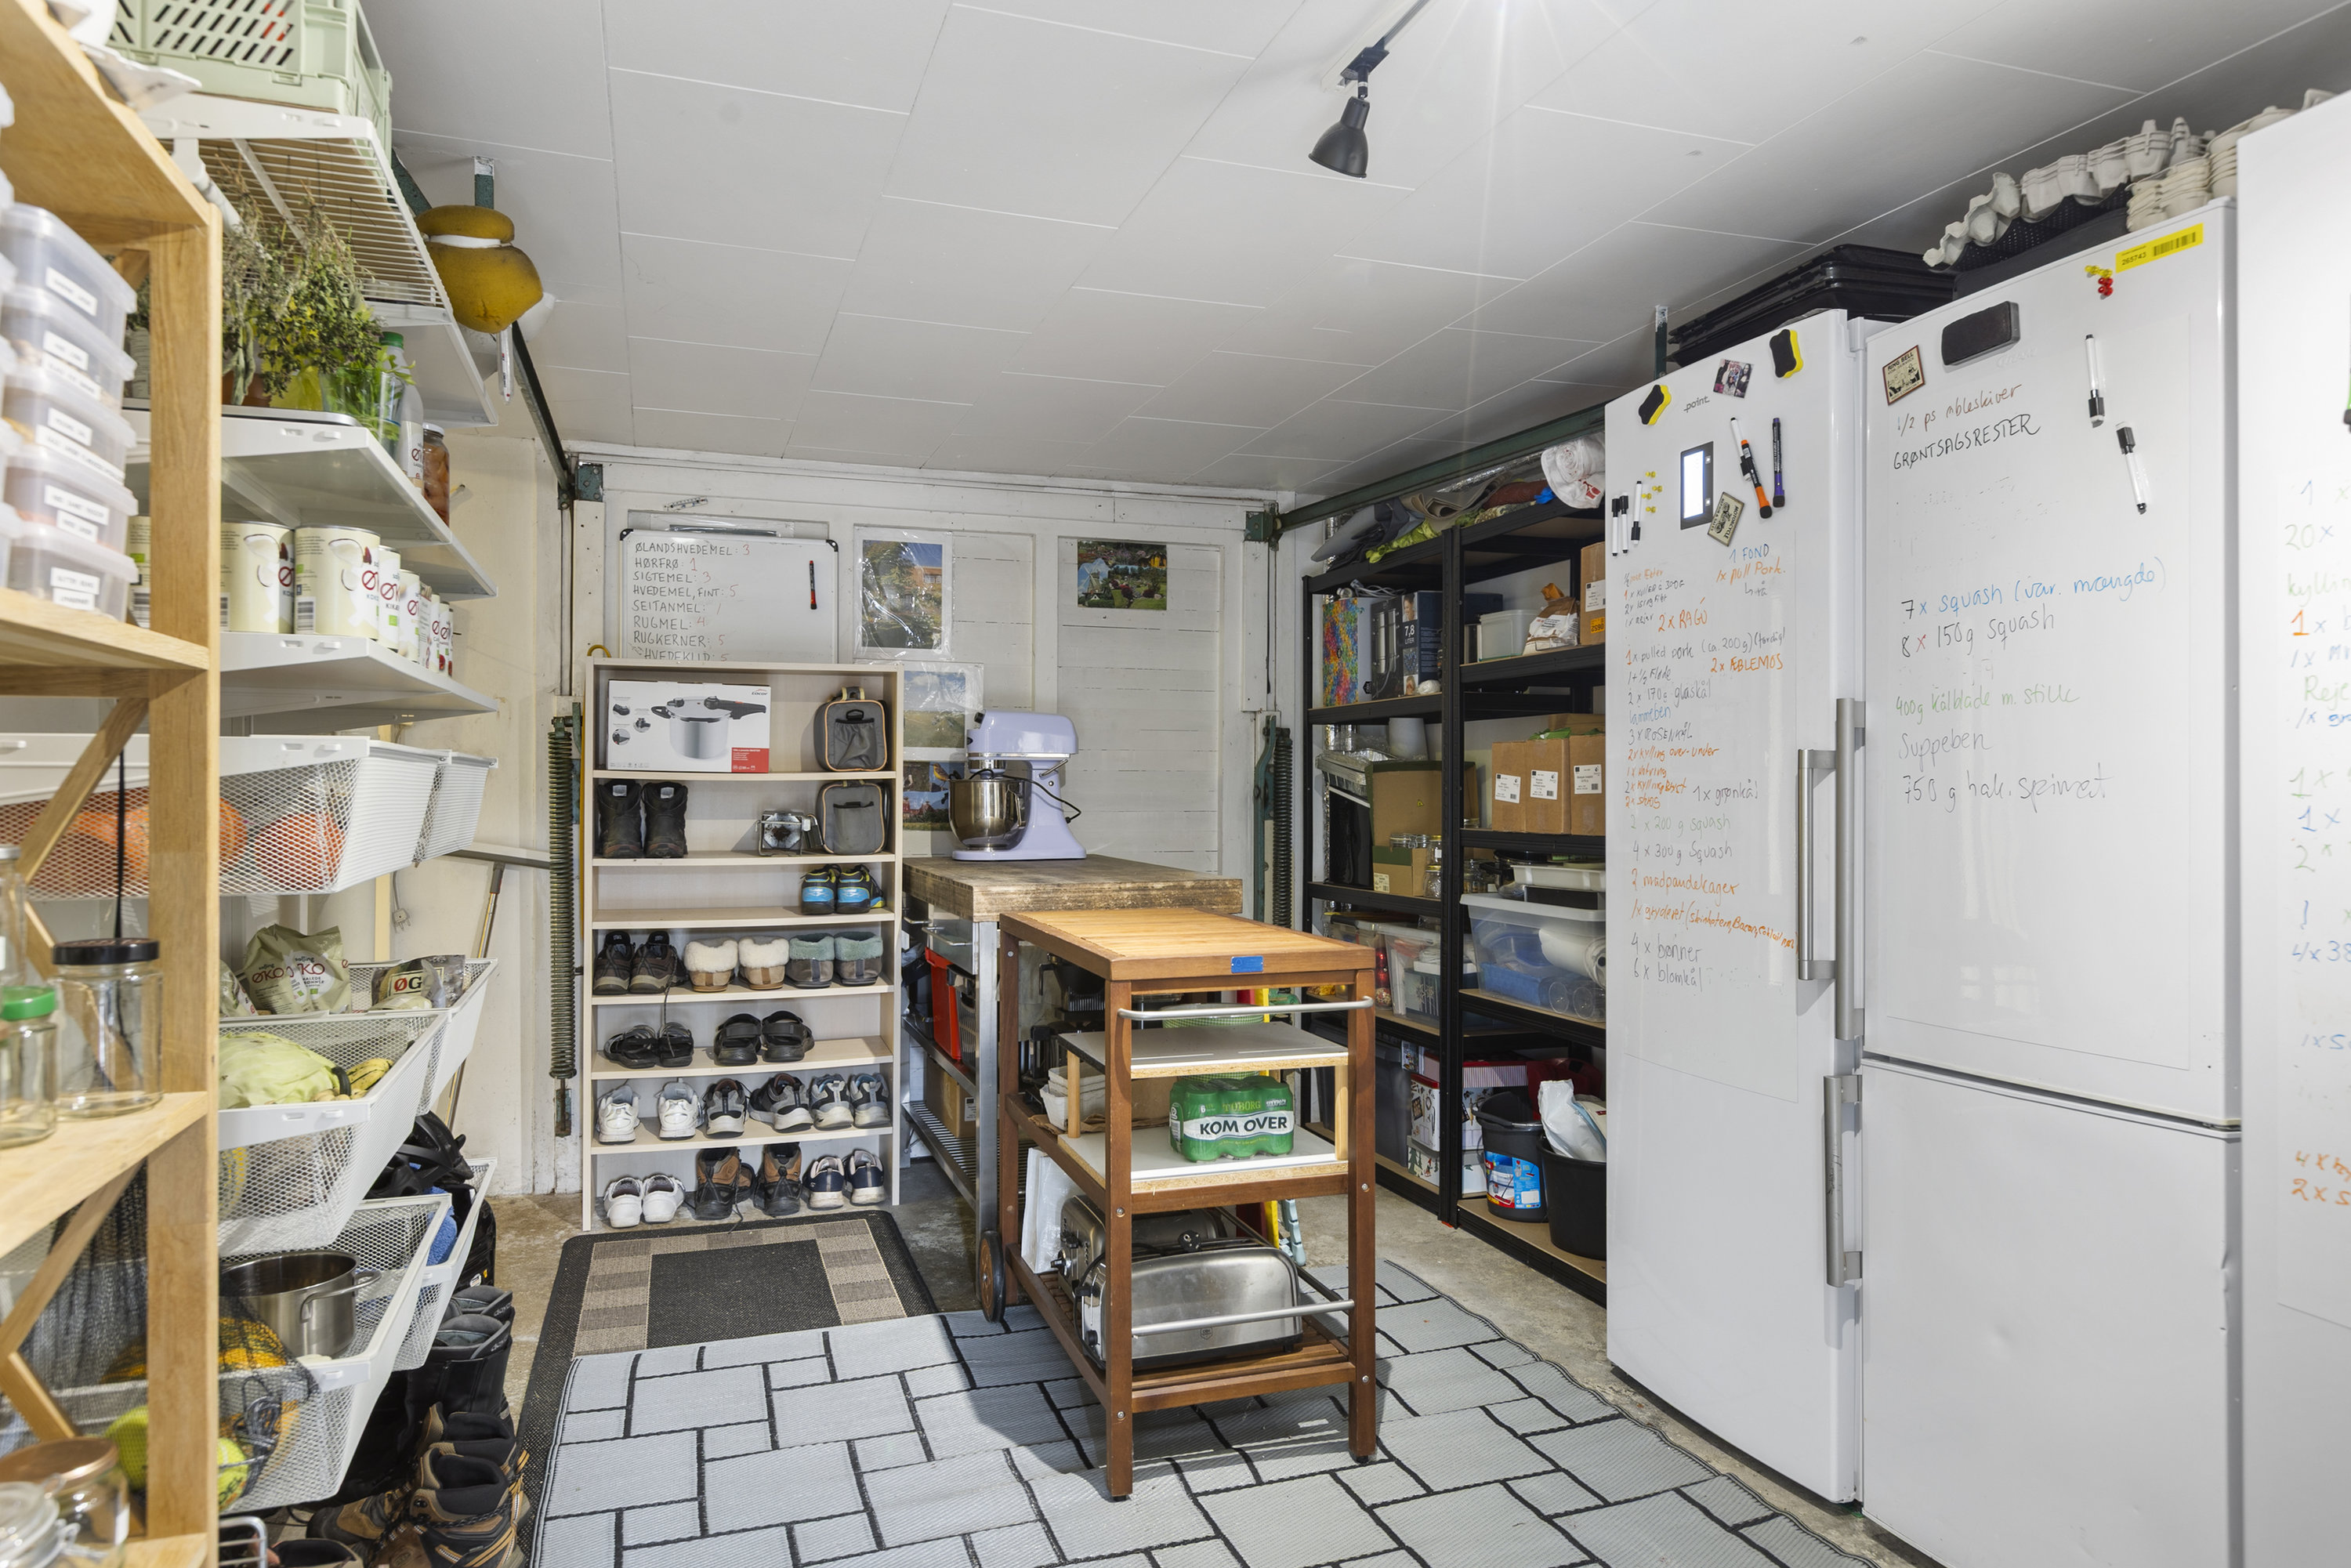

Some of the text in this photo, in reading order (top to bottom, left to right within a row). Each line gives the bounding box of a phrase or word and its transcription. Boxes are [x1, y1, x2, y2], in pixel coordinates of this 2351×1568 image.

[1901, 352, 1913, 363] BELL
[1893, 414, 2041, 469] GRØNTSAGSRESTER
[1725, 505, 1740, 539] MOTORCYCLE
[743, 544, 750, 556] 3
[1743, 544, 1769, 560] FOND
[690, 557, 697, 571] 1
[703, 571, 712, 583] 3
[730, 584, 739, 597] 5
[1939, 585, 2003, 617] squash
[1404, 624, 1415, 637] 7,8
[1987, 603, 2055, 650] squash
[719, 634, 726, 646] 5
[1641, 646, 1666, 662] pulled
[1690, 813, 1731, 840] squash
[297, 963, 325, 976] KO
[1200, 1117, 1288, 1135] KOM OVER
